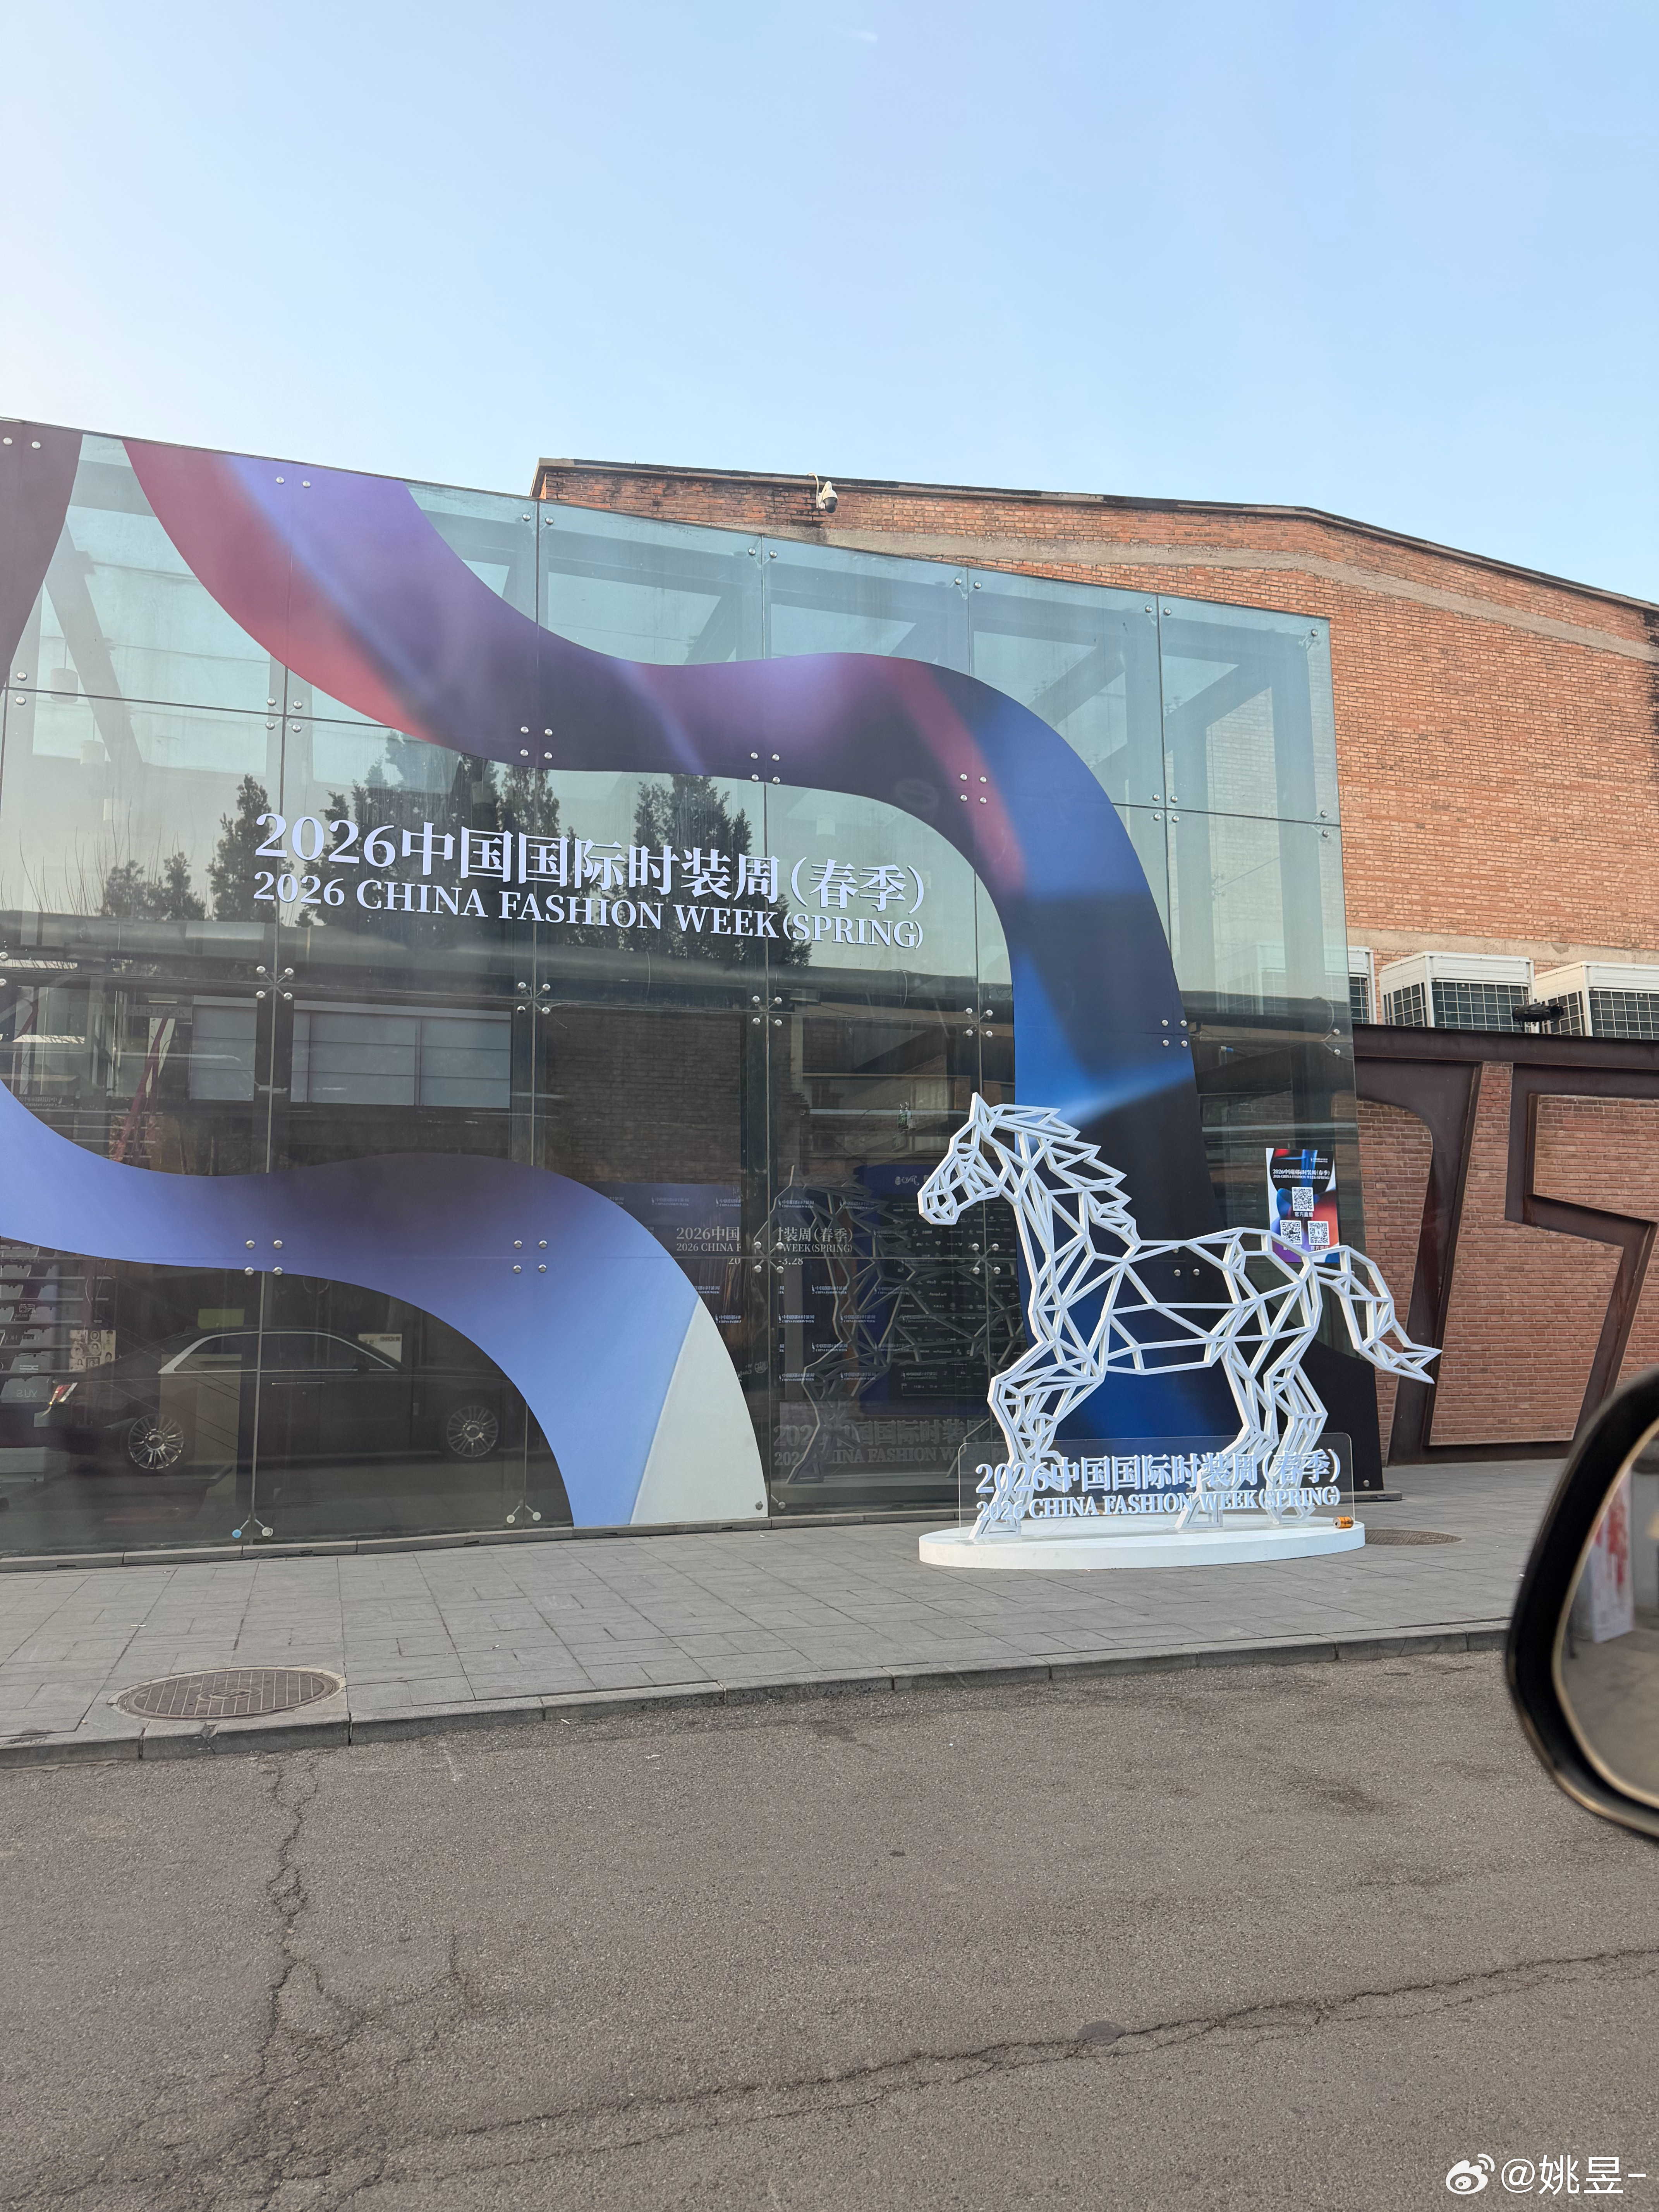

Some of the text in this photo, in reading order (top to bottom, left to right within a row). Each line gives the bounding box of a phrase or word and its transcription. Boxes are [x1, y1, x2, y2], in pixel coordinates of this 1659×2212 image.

[256, 814, 925, 914] 2026中国国际时装周（春季）
[254, 871, 345, 906] 2026
[357, 880, 489, 918] CHINA
[498, 891, 664, 930] FASHION
[676, 1243, 699, 1252] 2026
[701, 1243, 733, 1252] CHINA
[975, 1448, 1341, 1493] 2026中国国际时装周（春季）
[976, 1499, 1025, 1521] 2026
[1029, 1496, 1100, 1519] CHINA
[1102, 1492, 1194, 1515] FASHION
